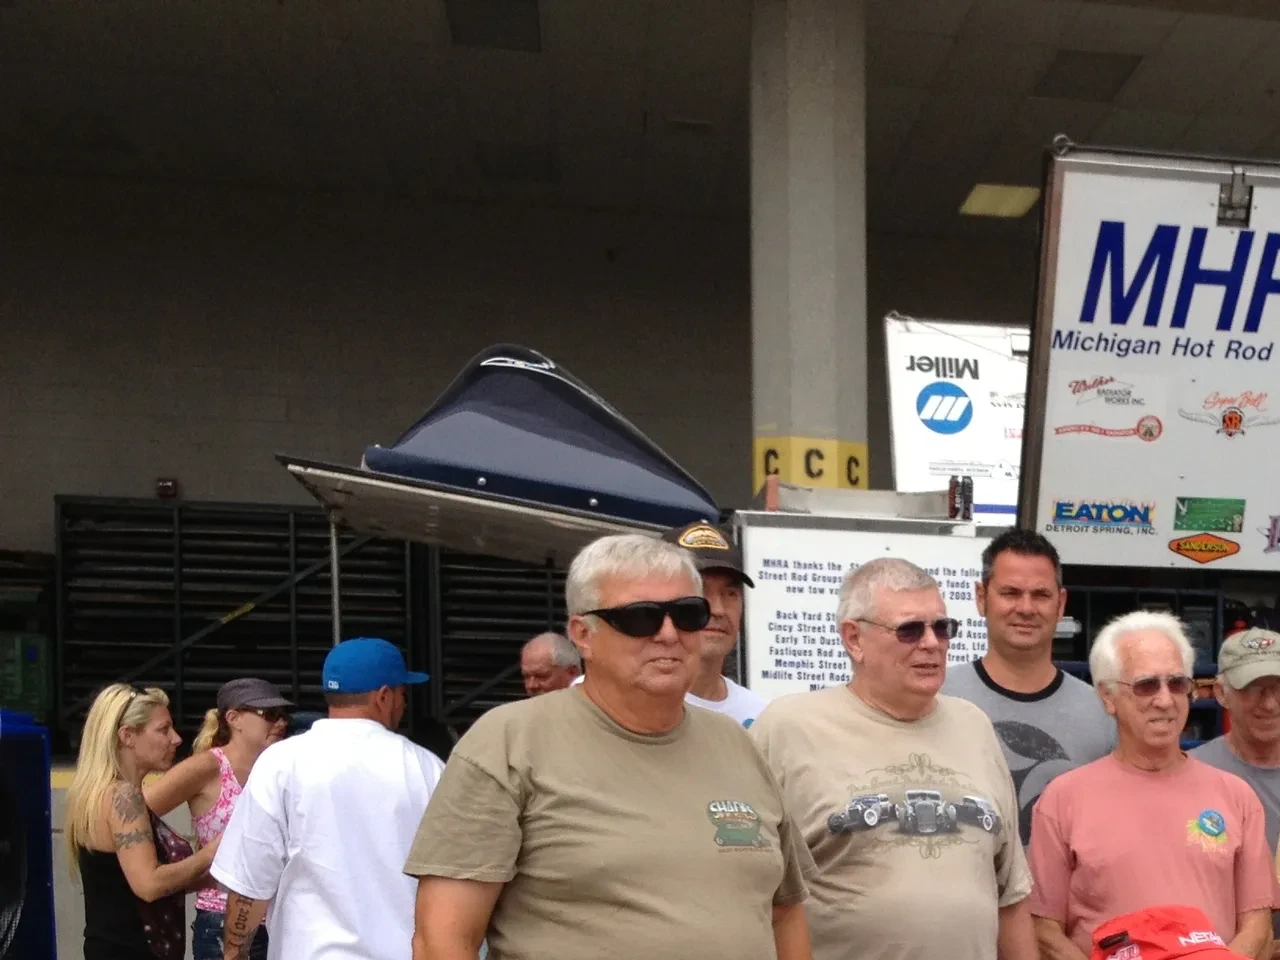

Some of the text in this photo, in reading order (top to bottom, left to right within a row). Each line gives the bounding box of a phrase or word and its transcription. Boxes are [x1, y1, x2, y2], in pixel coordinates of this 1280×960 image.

[1052, 330, 1161, 358] Michigan
[1171, 336, 1214, 359] Hot
[1224, 340, 1273, 363] Rod
[906, 354, 980, 380] Miller
[764, 448, 781, 477] C
[804, 448, 825, 479] C
[846, 455, 860, 487] C
[1055, 502, 1151, 522] EATON
[1045, 524, 1158, 536] DETROIT SPRING, INC.
[762, 558, 789, 569] MHRA
[793, 559, 824, 571] thanks
[828, 561, 842, 572] the
[942, 567, 957, 577] the
[758, 570, 971, 590] Street Rod Groups funds
[786, 586, 805, 594] new
[808, 586, 830, 595] tow
[776, 610, 798, 621] Back
[802, 611, 823, 622] Yard
[768, 622, 826, 634] Cincy Street
[775, 635, 798, 646] Early
[802, 635, 817, 645] Tin
[769, 646, 813, 659] Fastiques
[816, 648, 834, 658] Rod
[775, 659, 847, 671] Memphis Street
[761, 670, 850, 683] Midlife Street Rods
